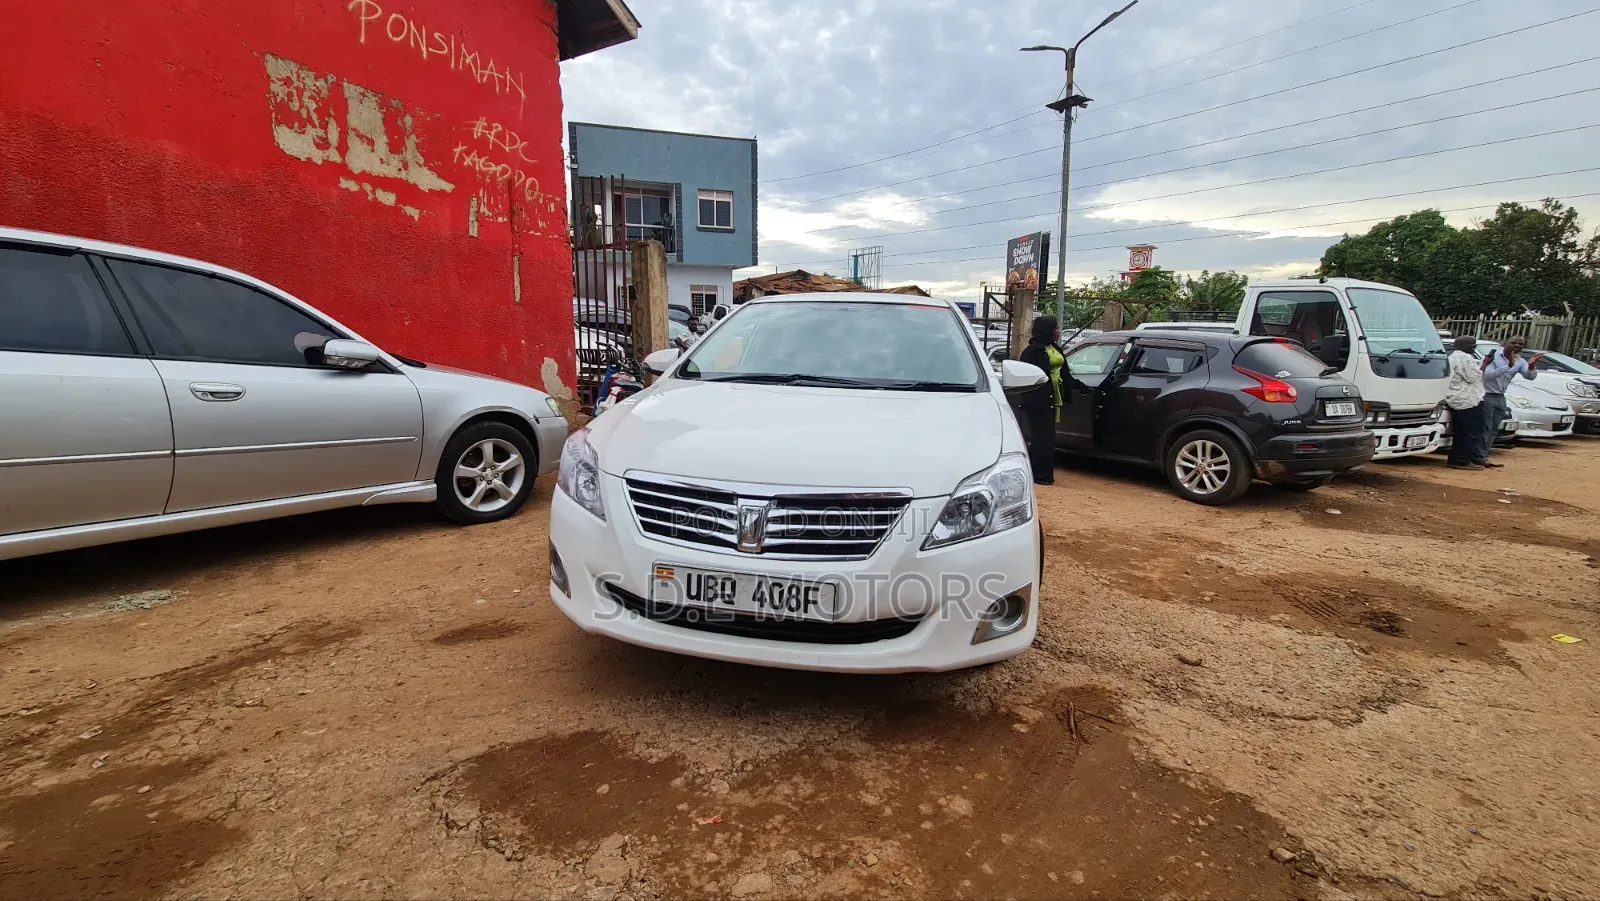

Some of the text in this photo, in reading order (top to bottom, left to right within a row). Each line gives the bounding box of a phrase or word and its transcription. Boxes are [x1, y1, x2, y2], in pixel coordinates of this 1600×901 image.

[1012, 247, 1032, 257] SHOW
[1013, 253, 1034, 265] DOWN
[686, 572, 820, 614] UBQ 408F
